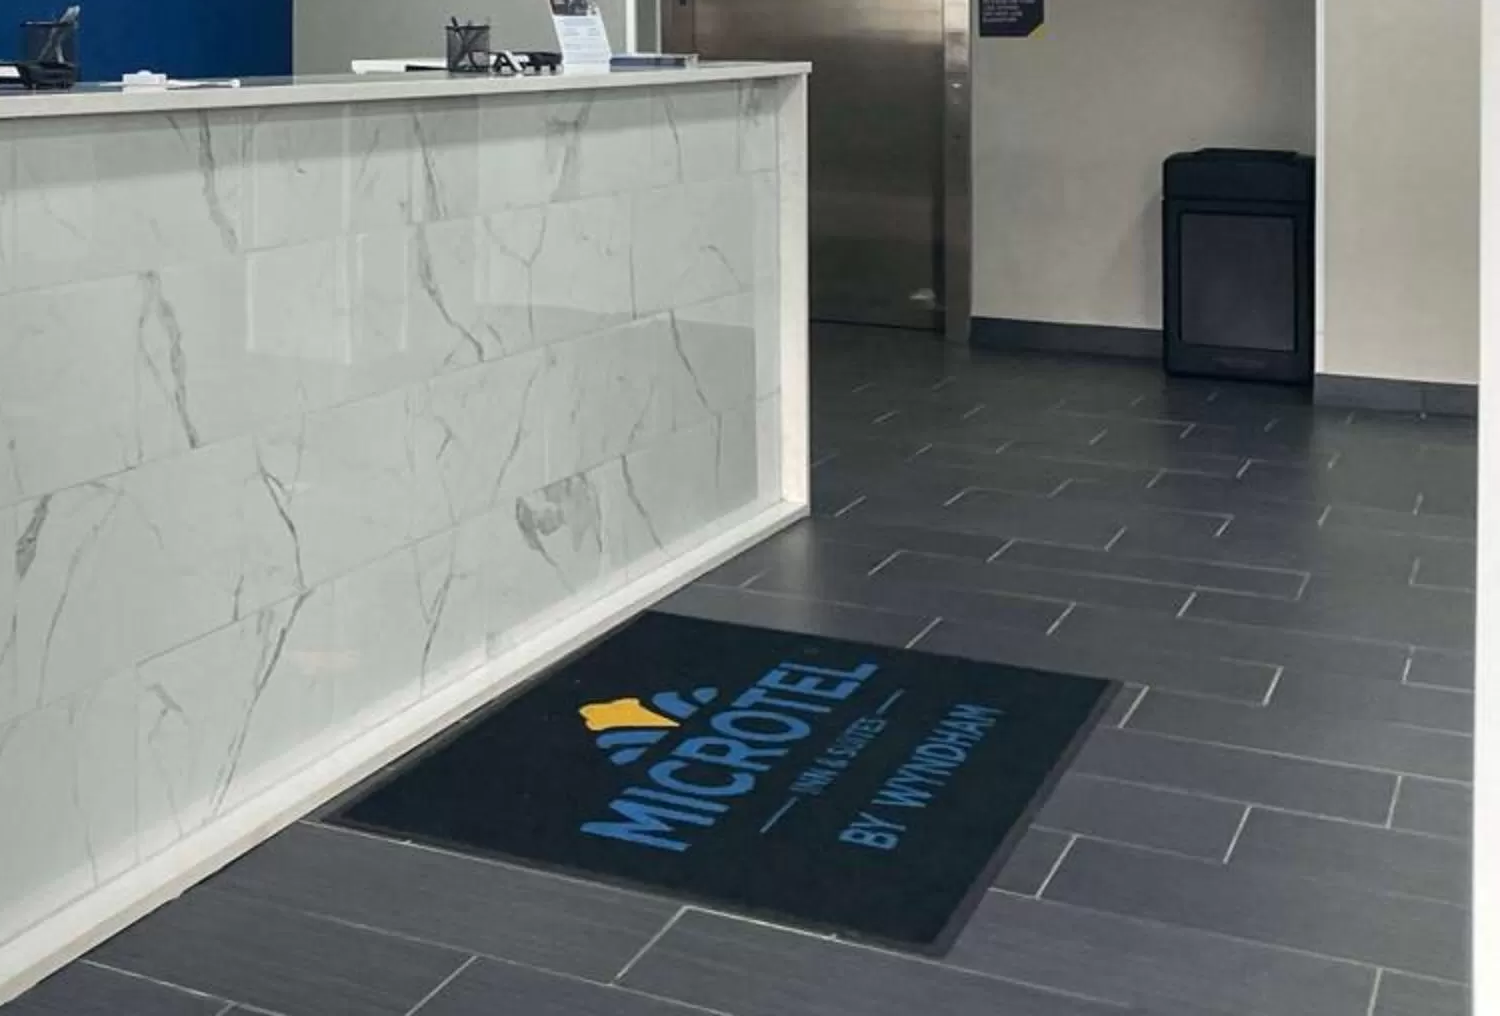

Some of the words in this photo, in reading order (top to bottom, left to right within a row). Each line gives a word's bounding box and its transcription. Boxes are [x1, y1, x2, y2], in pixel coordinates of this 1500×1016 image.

[579, 661, 879, 852] MICROTEL
[870, 703, 1005, 809] WYNDHAM
[838, 810, 907, 850] BY
